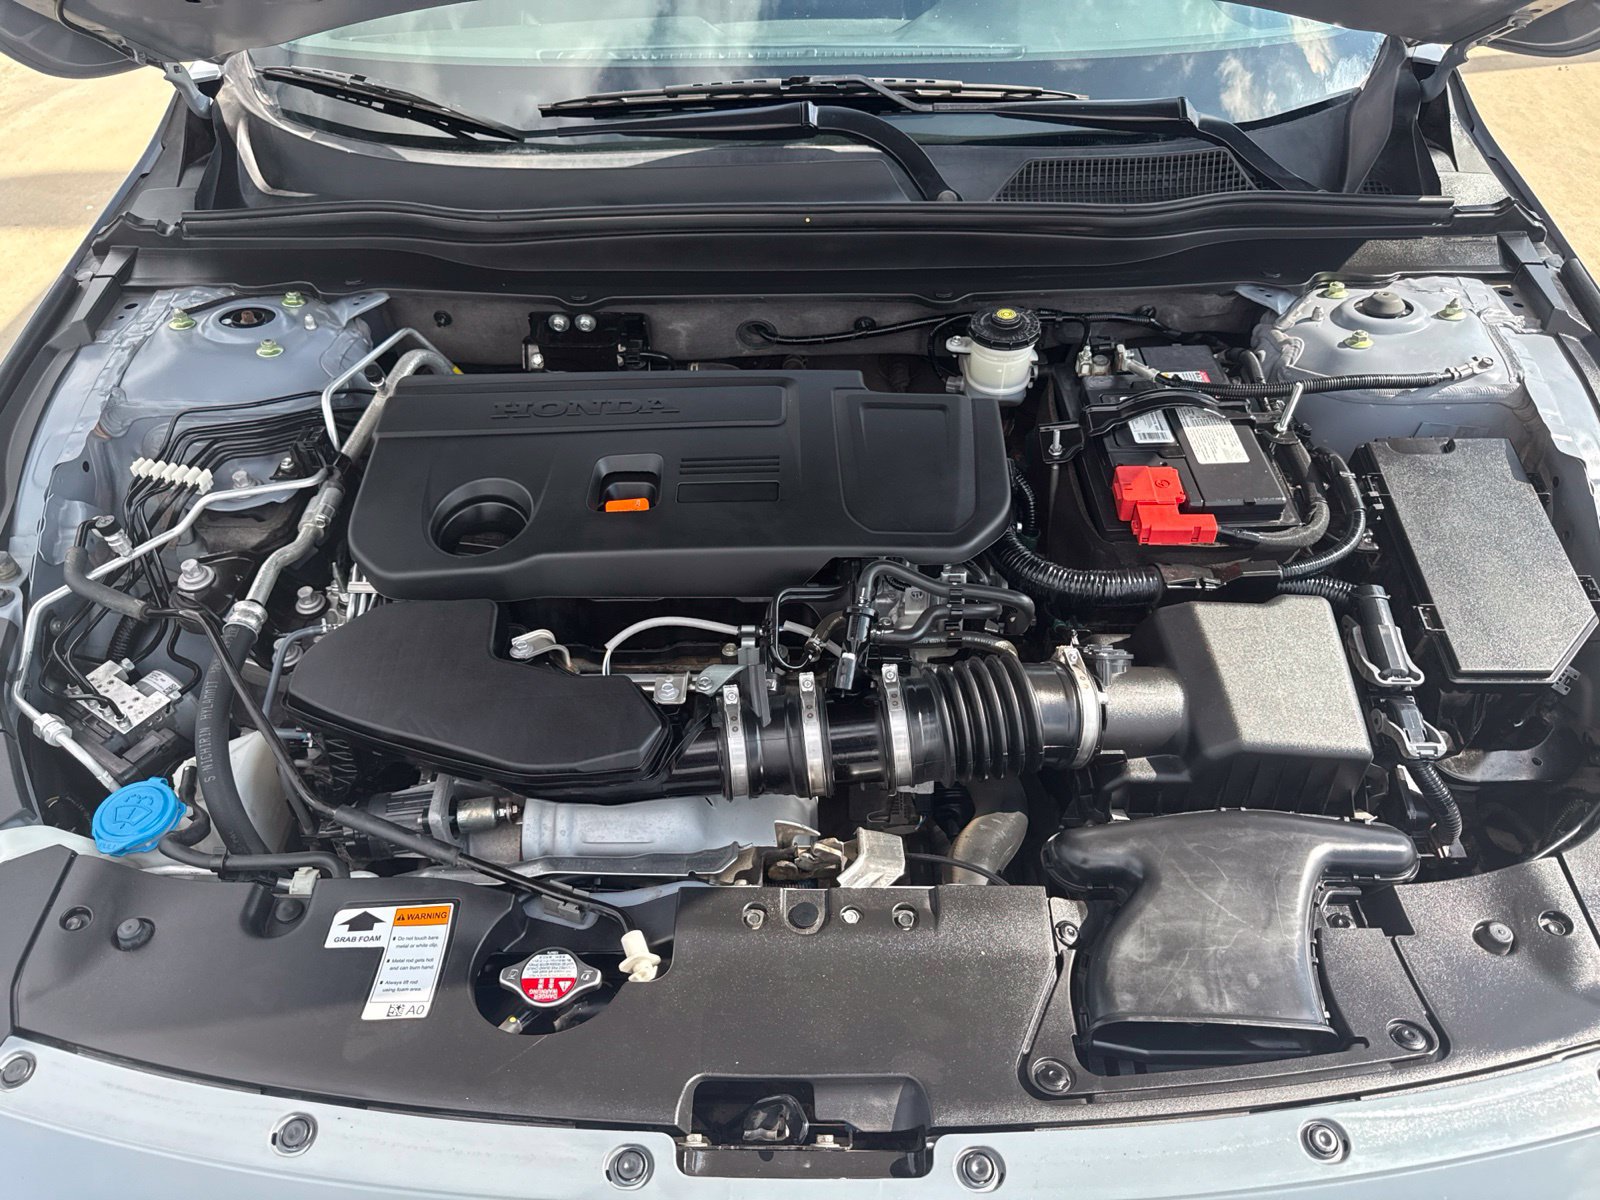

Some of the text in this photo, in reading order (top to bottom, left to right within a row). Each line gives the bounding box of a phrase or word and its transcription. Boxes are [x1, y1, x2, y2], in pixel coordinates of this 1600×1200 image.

[490, 399, 680, 419] HONDA
[199, 727, 213, 771] NICHIRIN
[407, 911, 447, 921] WARNING
[405, 1004, 425, 1016] A0
